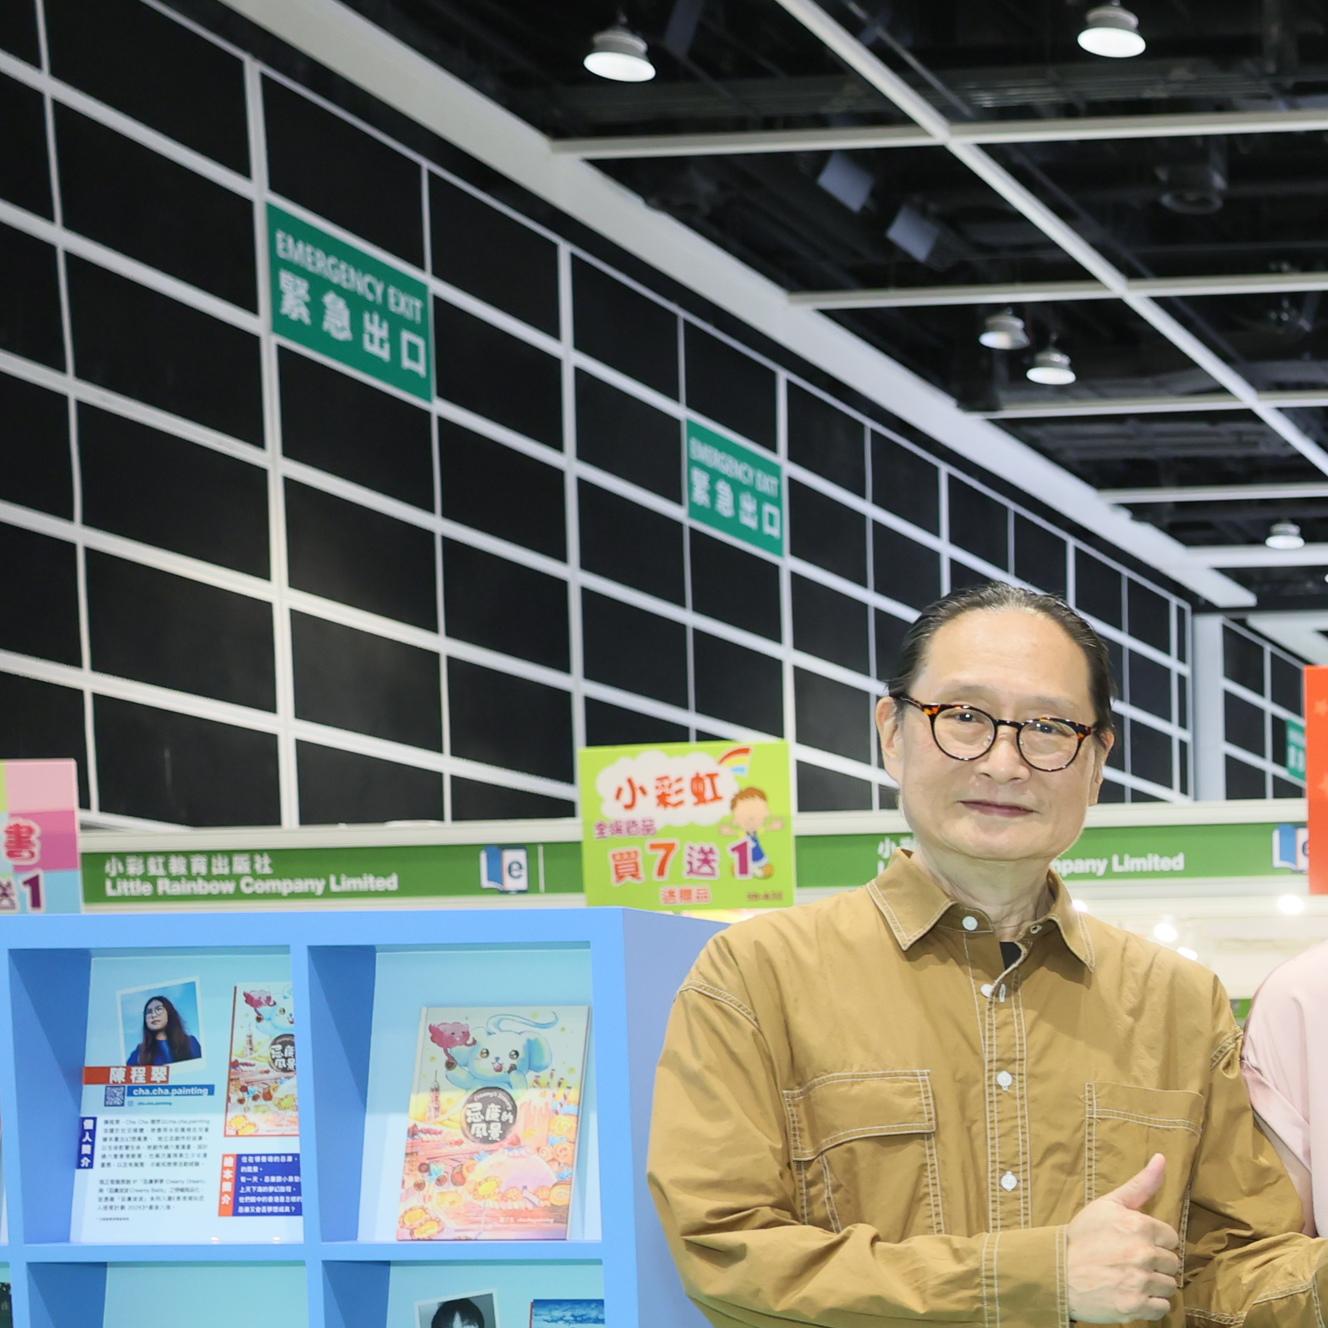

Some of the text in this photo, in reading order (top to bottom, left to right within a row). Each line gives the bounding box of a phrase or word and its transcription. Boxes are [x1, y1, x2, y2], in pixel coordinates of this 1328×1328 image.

[275, 229, 423, 324] EMERGENCY EXIT
[279, 267, 427, 378] 緊急出口
[689, 436, 778, 498] EMERGENCY EXIT
[691, 466, 781, 539] 緊急出口
[615, 773, 724, 811] 小彩虹
[105, 853, 273, 877] 小彩虹教育出版社
[611, 841, 752, 884] 買7送1
[1112, 852, 1184, 873] Limited
[105, 872, 398, 897] Little Rainbow Company Limited
[133, 1086, 208, 1096] cha.cha.painting
